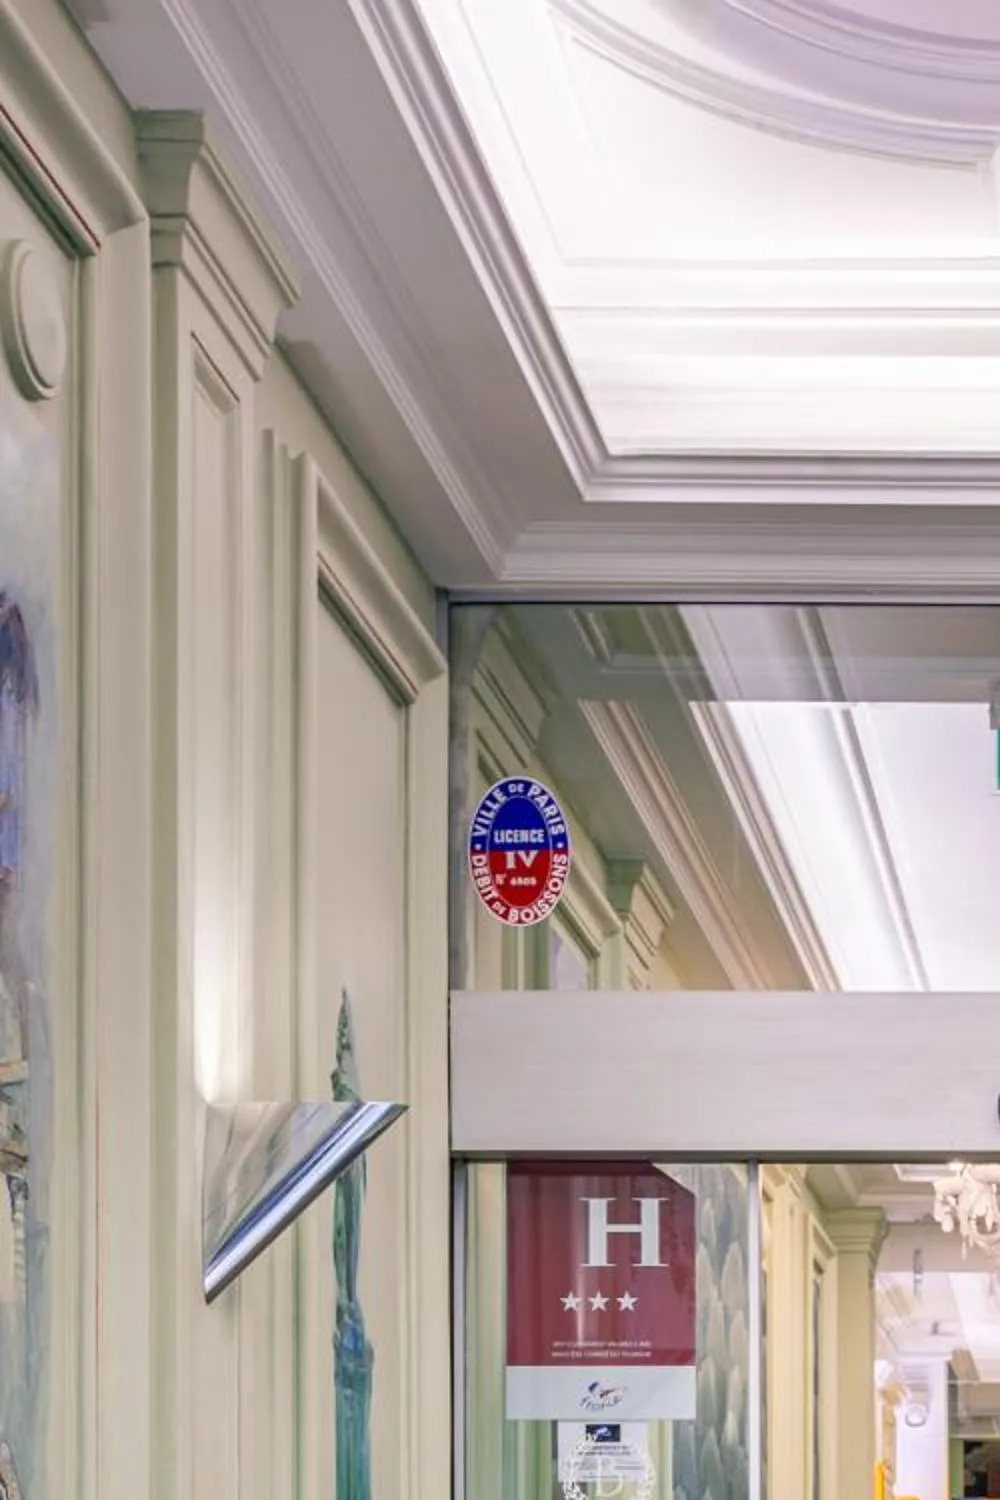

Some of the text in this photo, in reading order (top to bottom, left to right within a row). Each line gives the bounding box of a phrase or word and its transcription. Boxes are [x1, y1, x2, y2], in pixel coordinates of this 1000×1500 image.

[473, 783, 565, 837] VILLE DE PARIS
[493, 829, 545, 844] LICENCE
[505, 850, 538, 869] IV
[509, 854, 567, 922] BOISSONS
[580, 1197, 668, 1267] H
